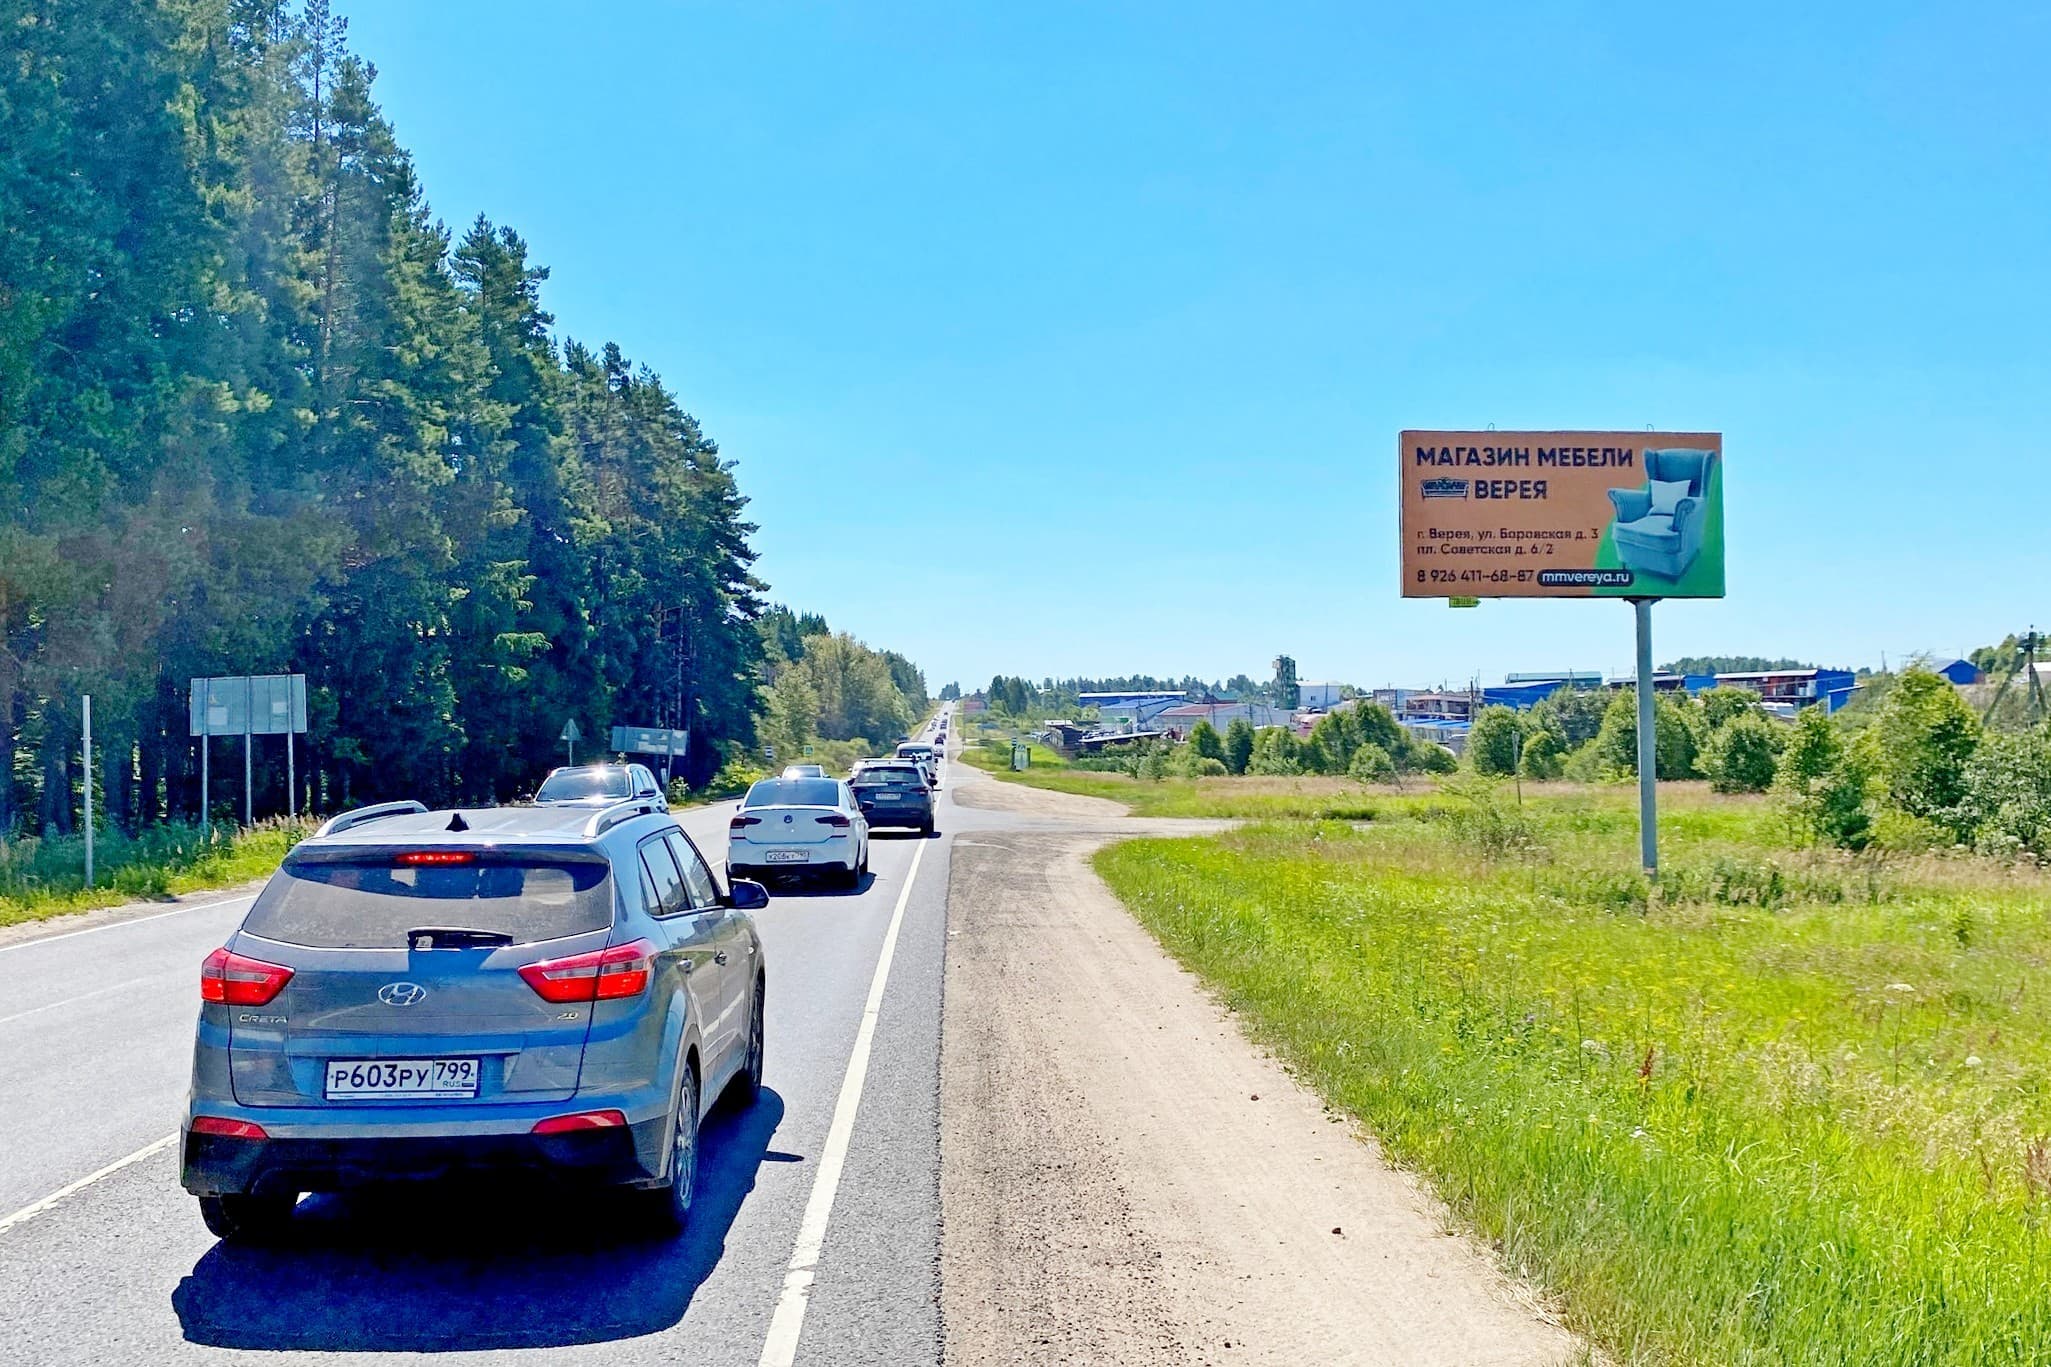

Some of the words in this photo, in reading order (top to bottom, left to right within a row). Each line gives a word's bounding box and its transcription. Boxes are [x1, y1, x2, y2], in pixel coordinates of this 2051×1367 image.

[1416, 447, 1530, 466] МАГАЗИН
[1537, 448, 1633, 467] МЕБЕЛИ
[1474, 479, 1547, 499] ВЕРЕЯ
[1429, 528, 1474, 541] Верея,
[1478, 531, 1496, 542] ул.
[1500, 528, 1572, 541] Боровская
[1575, 530, 1587, 540] д.
[1591, 528, 1599, 539] 3
[1417, 546, 1437, 555] пл.
[1440, 544, 1511, 555] Советская
[1514, 545, 1527, 556] д.
[1530, 544, 1554, 555] 6/2
[1417, 570, 1426, 582] 8
[1430, 570, 1457, 582] 926
[1460, 570, 1535, 582] 411-68-87
[1541, 571, 1630, 585] mmvereya.ru
[435, 1062, 472, 1081] 799
